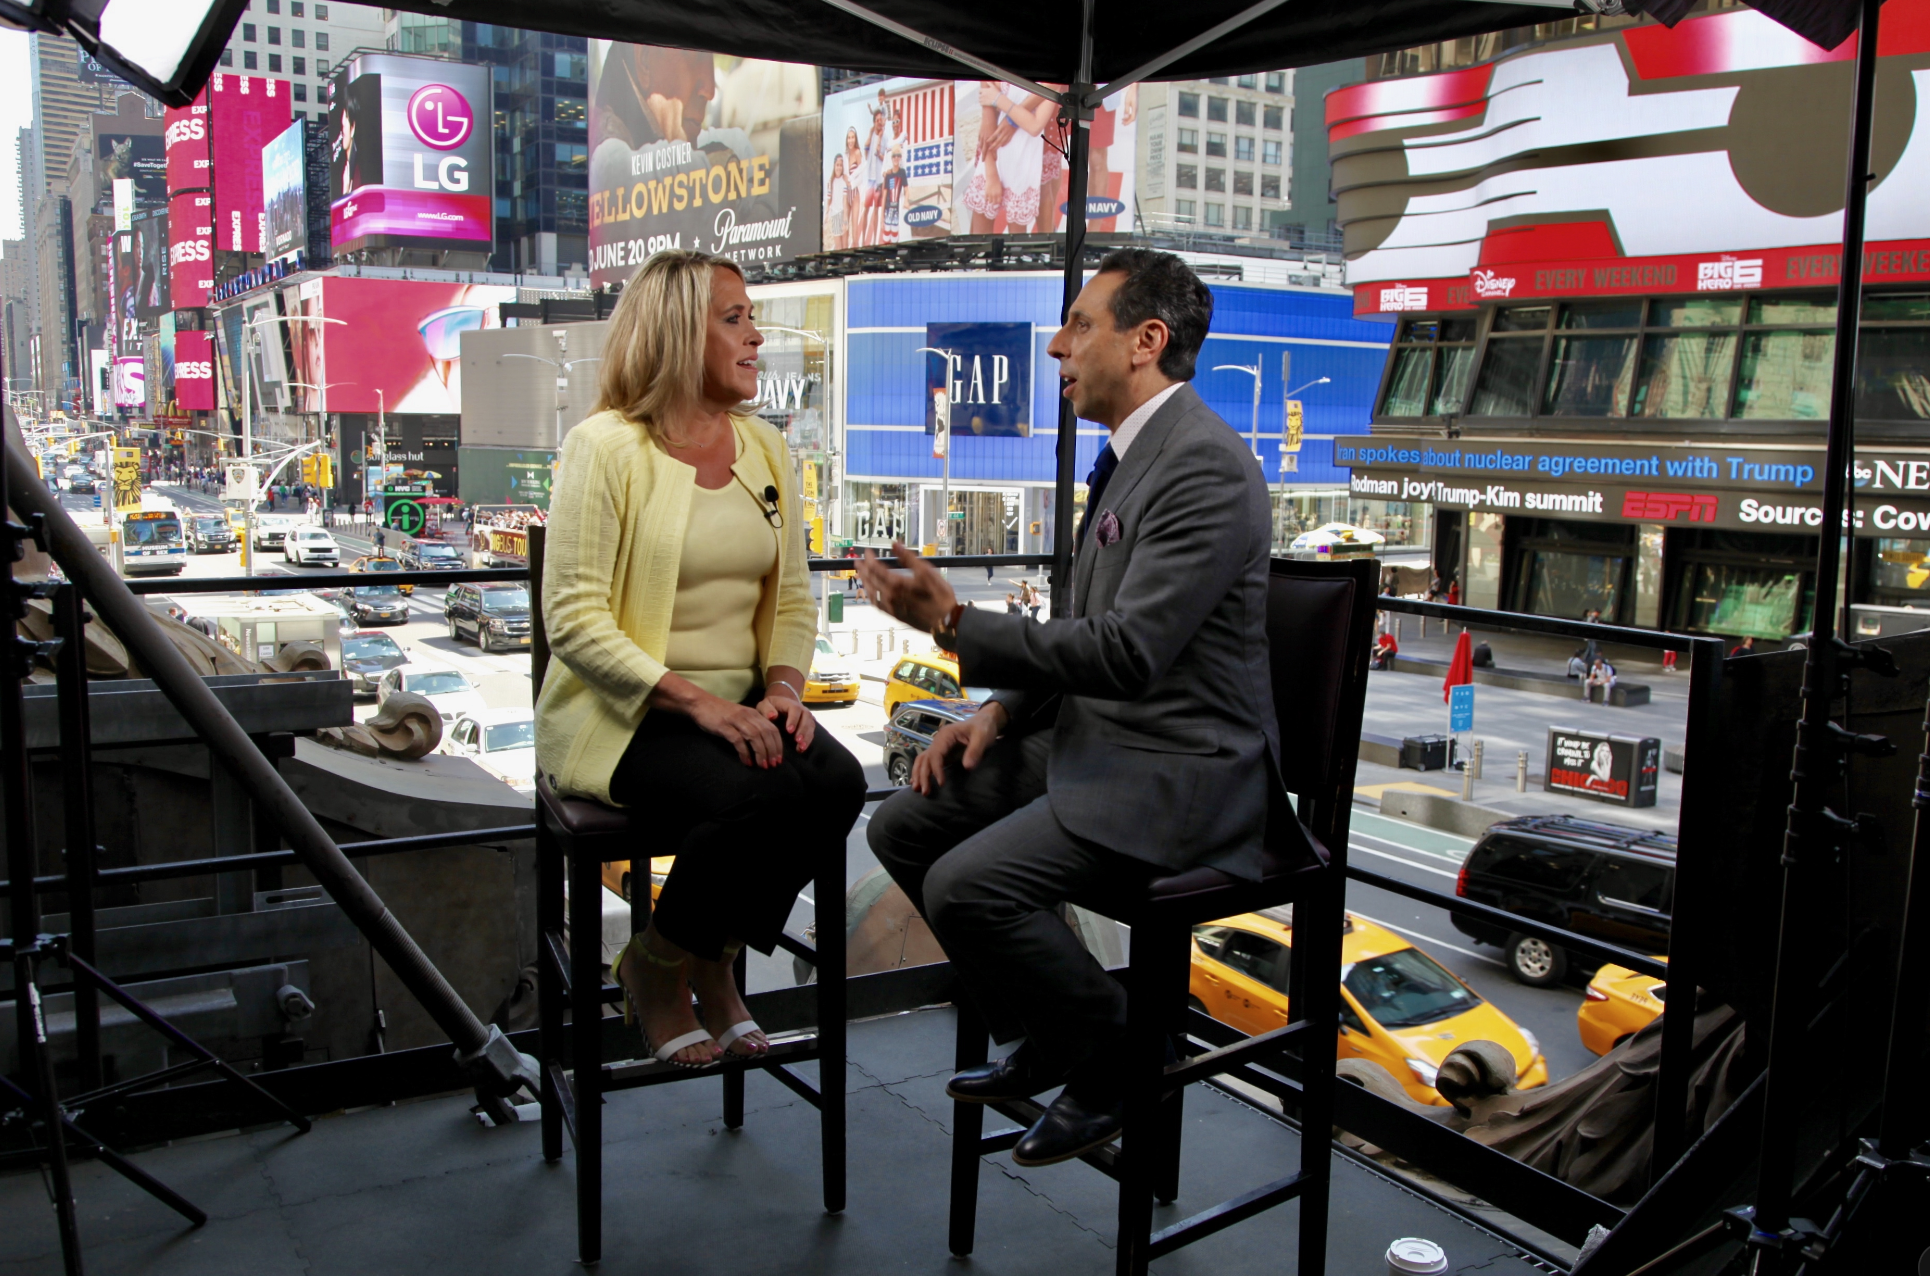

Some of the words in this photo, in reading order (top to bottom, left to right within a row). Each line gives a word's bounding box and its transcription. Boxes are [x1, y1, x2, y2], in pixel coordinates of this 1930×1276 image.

[924, 36, 949, 53] ECLIPSE
[414, 153, 469, 192] LG
[631, 149, 654, 176] KEVIN
[655, 141, 692, 171] COSTNER
[418, 212, 464, 222] www.LG.com
[908, 212, 920, 223] OLD
[921, 209, 938, 222] NAVY
[1088, 202, 1118, 214] NAVY
[711, 208, 793, 255] Paramount
[594, 242, 625, 271] JUNE
[628, 238, 645, 266] 20
[724, 245, 782, 263] NETWORK
[1863, 249, 1930, 275] WEEKE
[1535, 268, 1587, 290] EVERY
[1593, 264, 1677, 289] WEEKEND
[1697, 261, 1733, 280] BIG
[1697, 278, 1732, 290] HERO
[1733, 259, 1763, 284] 6
[1380, 302, 1403, 312] HERO
[1404, 287, 1428, 307] 6
[1381, 289, 1404, 303] BIG
[949, 354, 1009, 405] GAP
[408, 451, 424, 461] hut
[1359, 445, 1421, 466] spokes
[1422, 447, 1462, 469] about
[1464, 450, 1533, 471] nuclear
[1538, 454, 1660, 477] agreement
[1665, 455, 1719, 479] with
[1726, 457, 1815, 488] Trump
[1350, 474, 1398, 495] Rodman
[1437, 482, 1520, 508] Trump-Kim
[1525, 491, 1603, 513] summit
[1622, 491, 1718, 522] ESPN
[857, 508, 905, 541] GAP
[1739, 498, 1864, 528] Sourcs:
